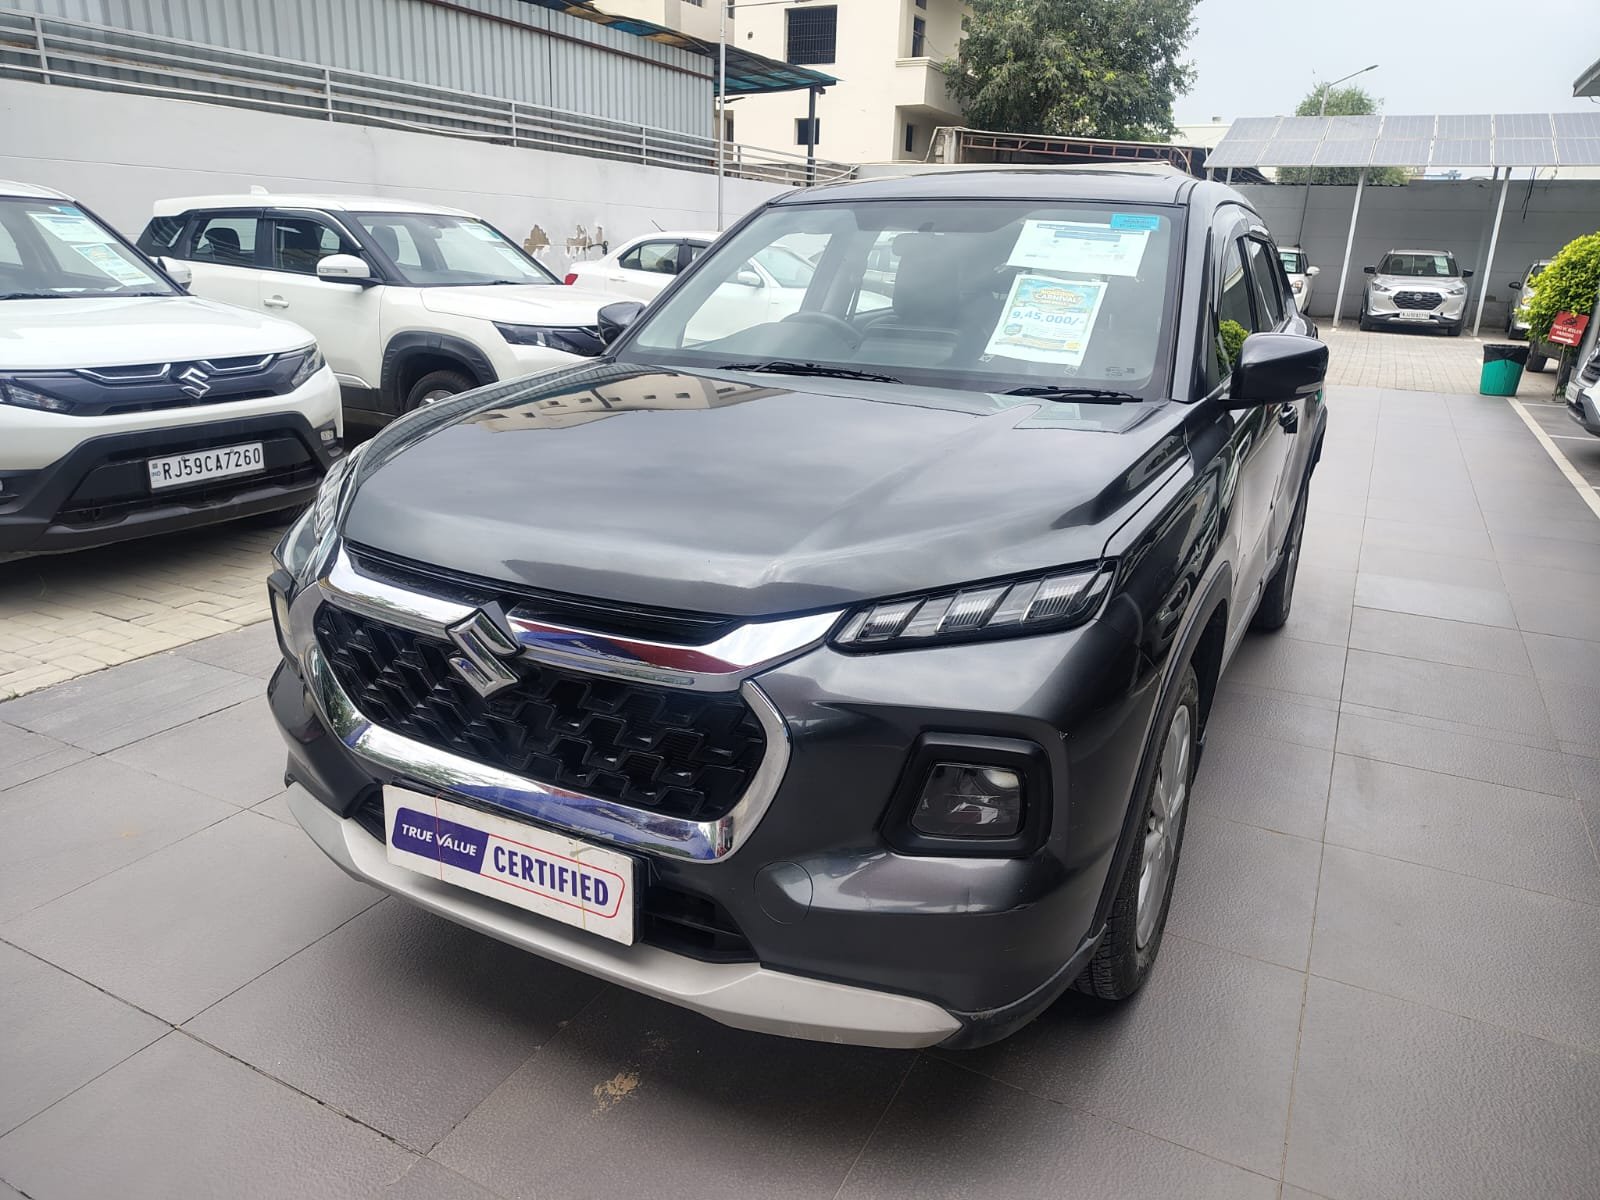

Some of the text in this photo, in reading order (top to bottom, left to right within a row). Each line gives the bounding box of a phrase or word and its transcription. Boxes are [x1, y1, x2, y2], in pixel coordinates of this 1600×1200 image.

[1012, 310, 1084, 325] 9,45,000/-
[162, 448, 260, 480] RJ59CA7260
[402, 823, 477, 857] TRUE VALUE
[493, 845, 609, 906] CERTIFIED
